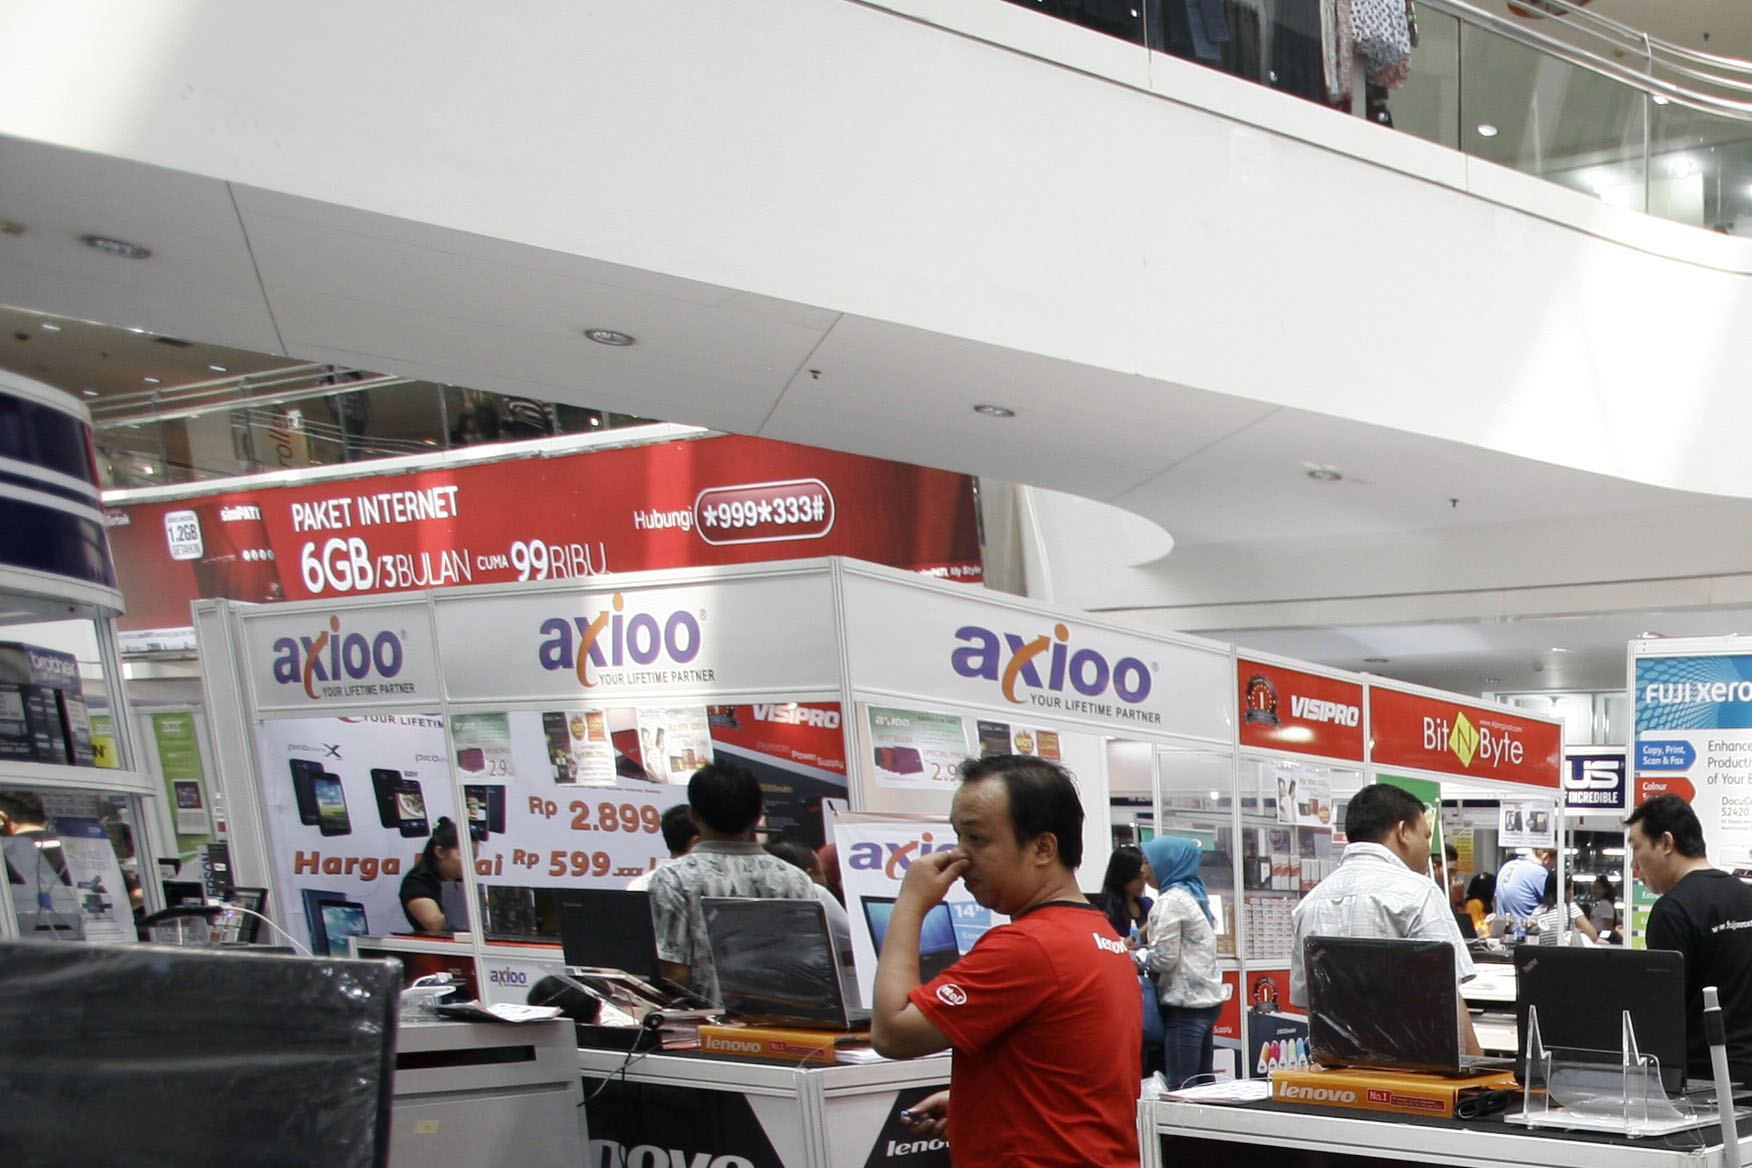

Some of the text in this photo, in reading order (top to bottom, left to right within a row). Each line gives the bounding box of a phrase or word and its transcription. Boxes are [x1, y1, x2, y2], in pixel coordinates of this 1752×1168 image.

[291, 486, 459, 532] PAKET INTERNET
[633, 506, 694, 532] Hubungi
[168, 524, 199, 542] 1.2GB
[476, 554, 510, 571] CUMA
[538, 591, 702, 689] axioo
[31, 653, 77, 676] brother
[272, 615, 404, 699] axioo
[951, 622, 1153, 704] axioo
[599, 669, 716, 686] YOUR LIFETIME PARTNER
[322, 682, 417, 698] YOUR LIFETIME PARTNER
[1646, 682, 1692, 704] FUJI
[752, 703, 842, 729] VISIPRO
[1030, 693, 1162, 725] YOUR LIFETIME PARTNER
[1290, 695, 1360, 728] VISIPRO
[1423, 716, 1449, 752] Bit
[1479, 734, 1525, 768] Byte
[1643, 745, 1687, 757] Copy, Print,
[1642, 756, 1685, 766] Scan & Fax
[1642, 781, 1667, 792] Colour
[1707, 772, 1745, 785] of Your
[1568, 791, 1619, 806] INCREDIBLE
[529, 797, 660, 833] Rp 2.899
[294, 851, 401, 881] Harga
[512, 849, 539, 869] Rp
[489, 968, 528, 985] axioo
[706, 1034, 762, 1053] lenovo
[1279, 1080, 1357, 1103] lenovo
[1370, 1091, 1387, 1102] No.1
